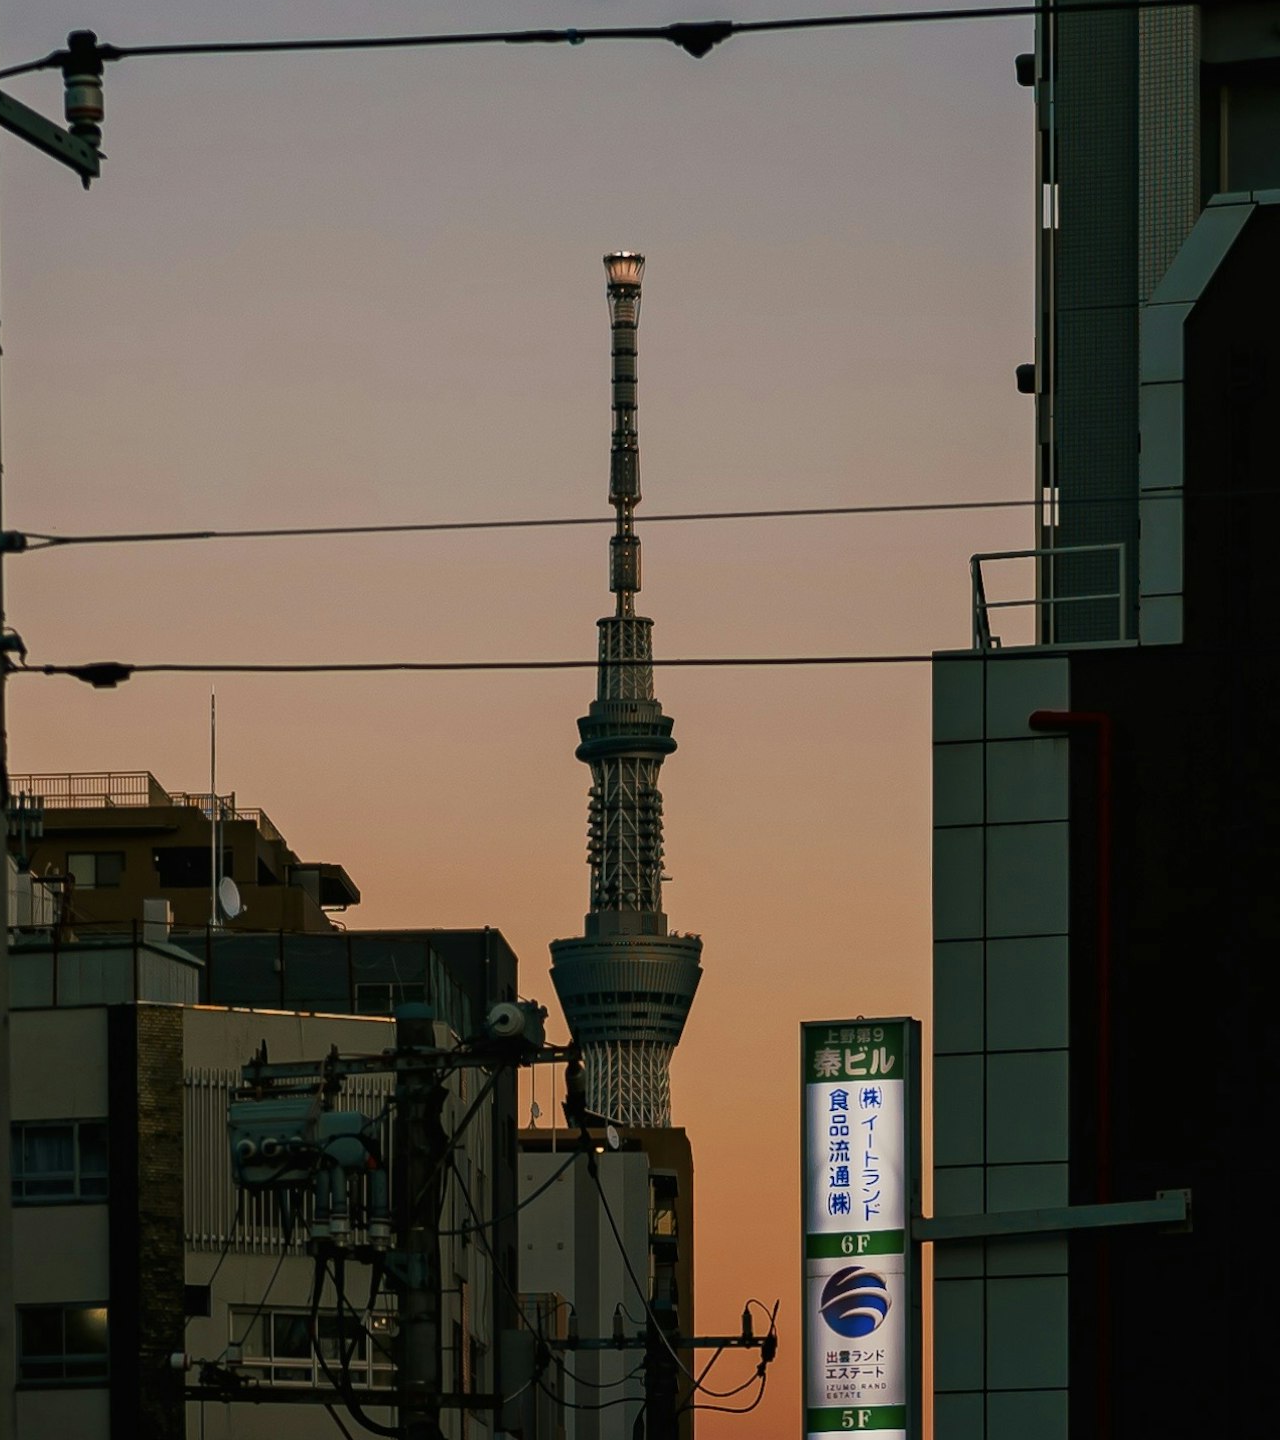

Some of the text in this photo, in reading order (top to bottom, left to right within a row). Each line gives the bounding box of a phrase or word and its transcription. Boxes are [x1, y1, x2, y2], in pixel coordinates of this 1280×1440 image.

[841, 1234, 871, 1254] 6F
[826, 1366, 884, 1379] エステート
[841, 1409, 872, 1428] 5F
